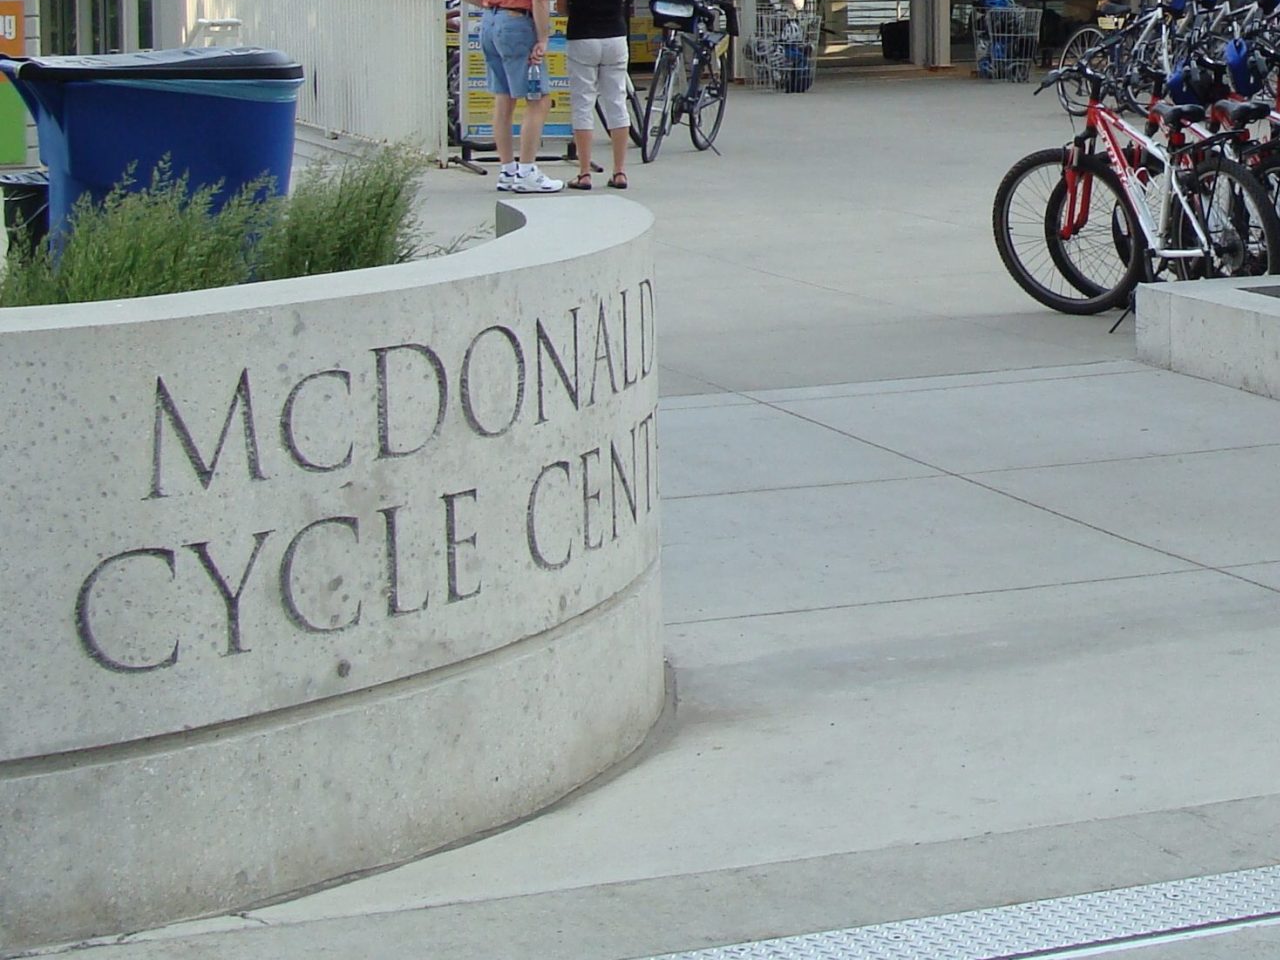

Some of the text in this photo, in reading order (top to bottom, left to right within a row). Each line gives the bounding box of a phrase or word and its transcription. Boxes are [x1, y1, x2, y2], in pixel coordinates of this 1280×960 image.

[140, 277, 655, 501] MCDONALD
[74, 403, 659, 674] CYCLE CENT
